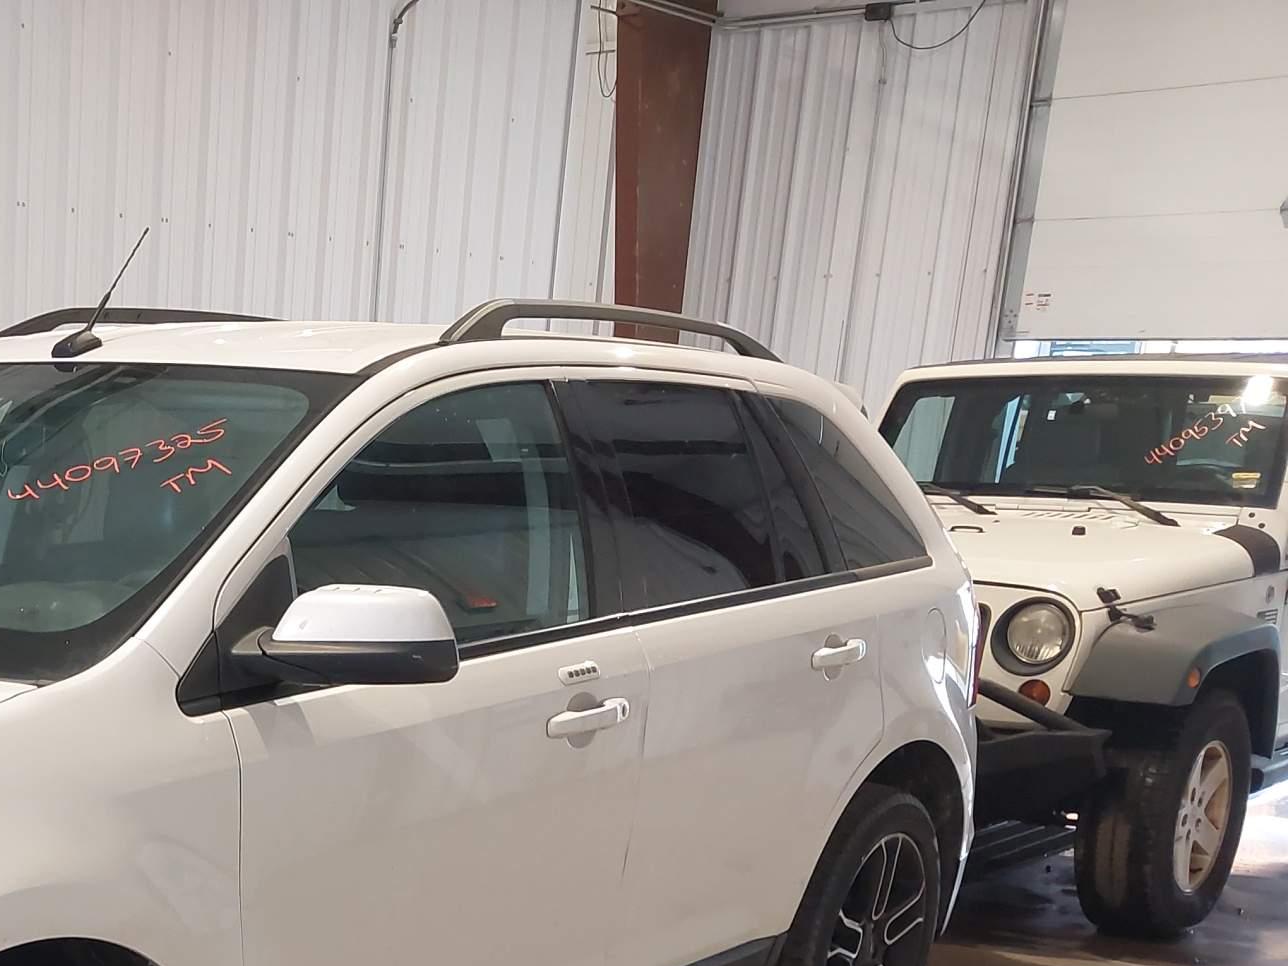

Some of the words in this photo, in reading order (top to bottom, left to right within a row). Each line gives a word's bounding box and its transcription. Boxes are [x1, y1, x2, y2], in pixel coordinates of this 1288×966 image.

[1225, 420, 1267, 448] TM
[7, 418, 228, 501] 44097325
[160, 458, 232, 494] TM
